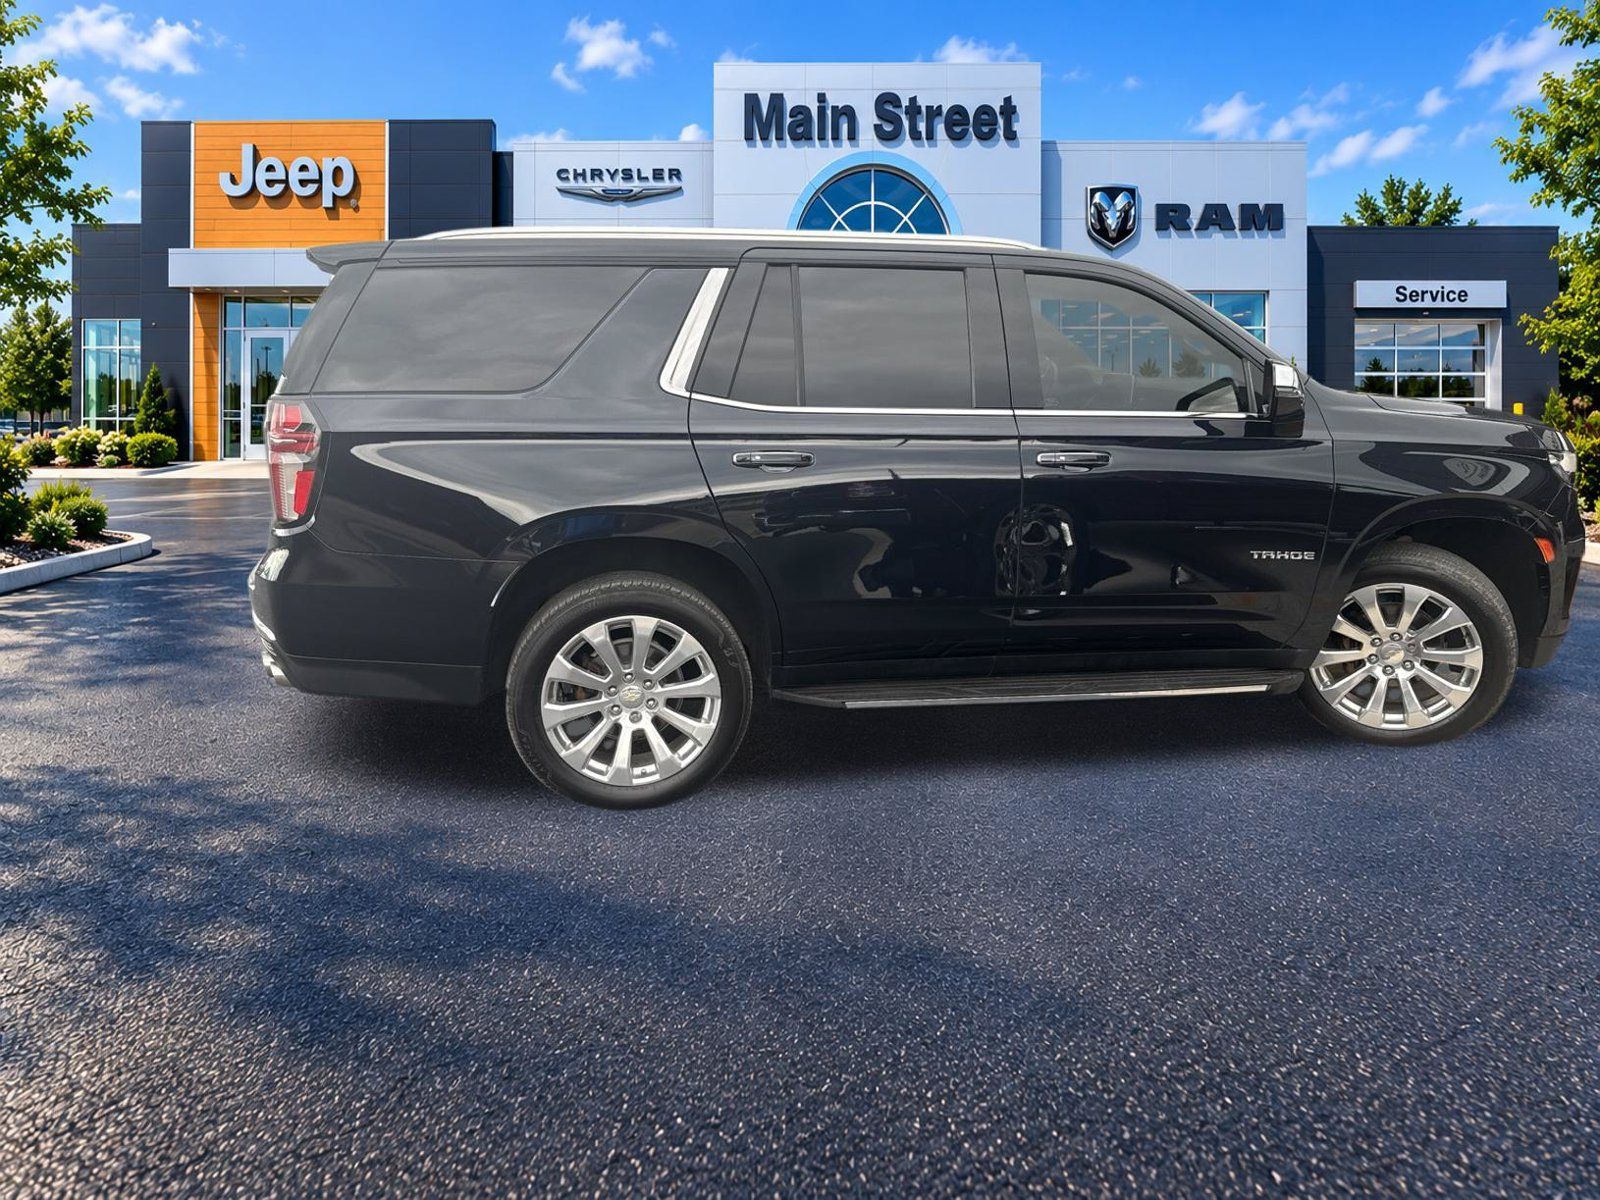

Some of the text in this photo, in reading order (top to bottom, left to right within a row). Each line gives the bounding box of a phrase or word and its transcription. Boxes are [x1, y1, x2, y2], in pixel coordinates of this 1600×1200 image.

[744, 91, 1017, 141] Main Street
[219, 143, 355, 208] Jeep
[556, 167, 682, 182] CHRYSLER
[1155, 203, 1284, 232] RAM
[1395, 285, 1468, 303] Service
[1250, 550, 1315, 560] TAHOE
